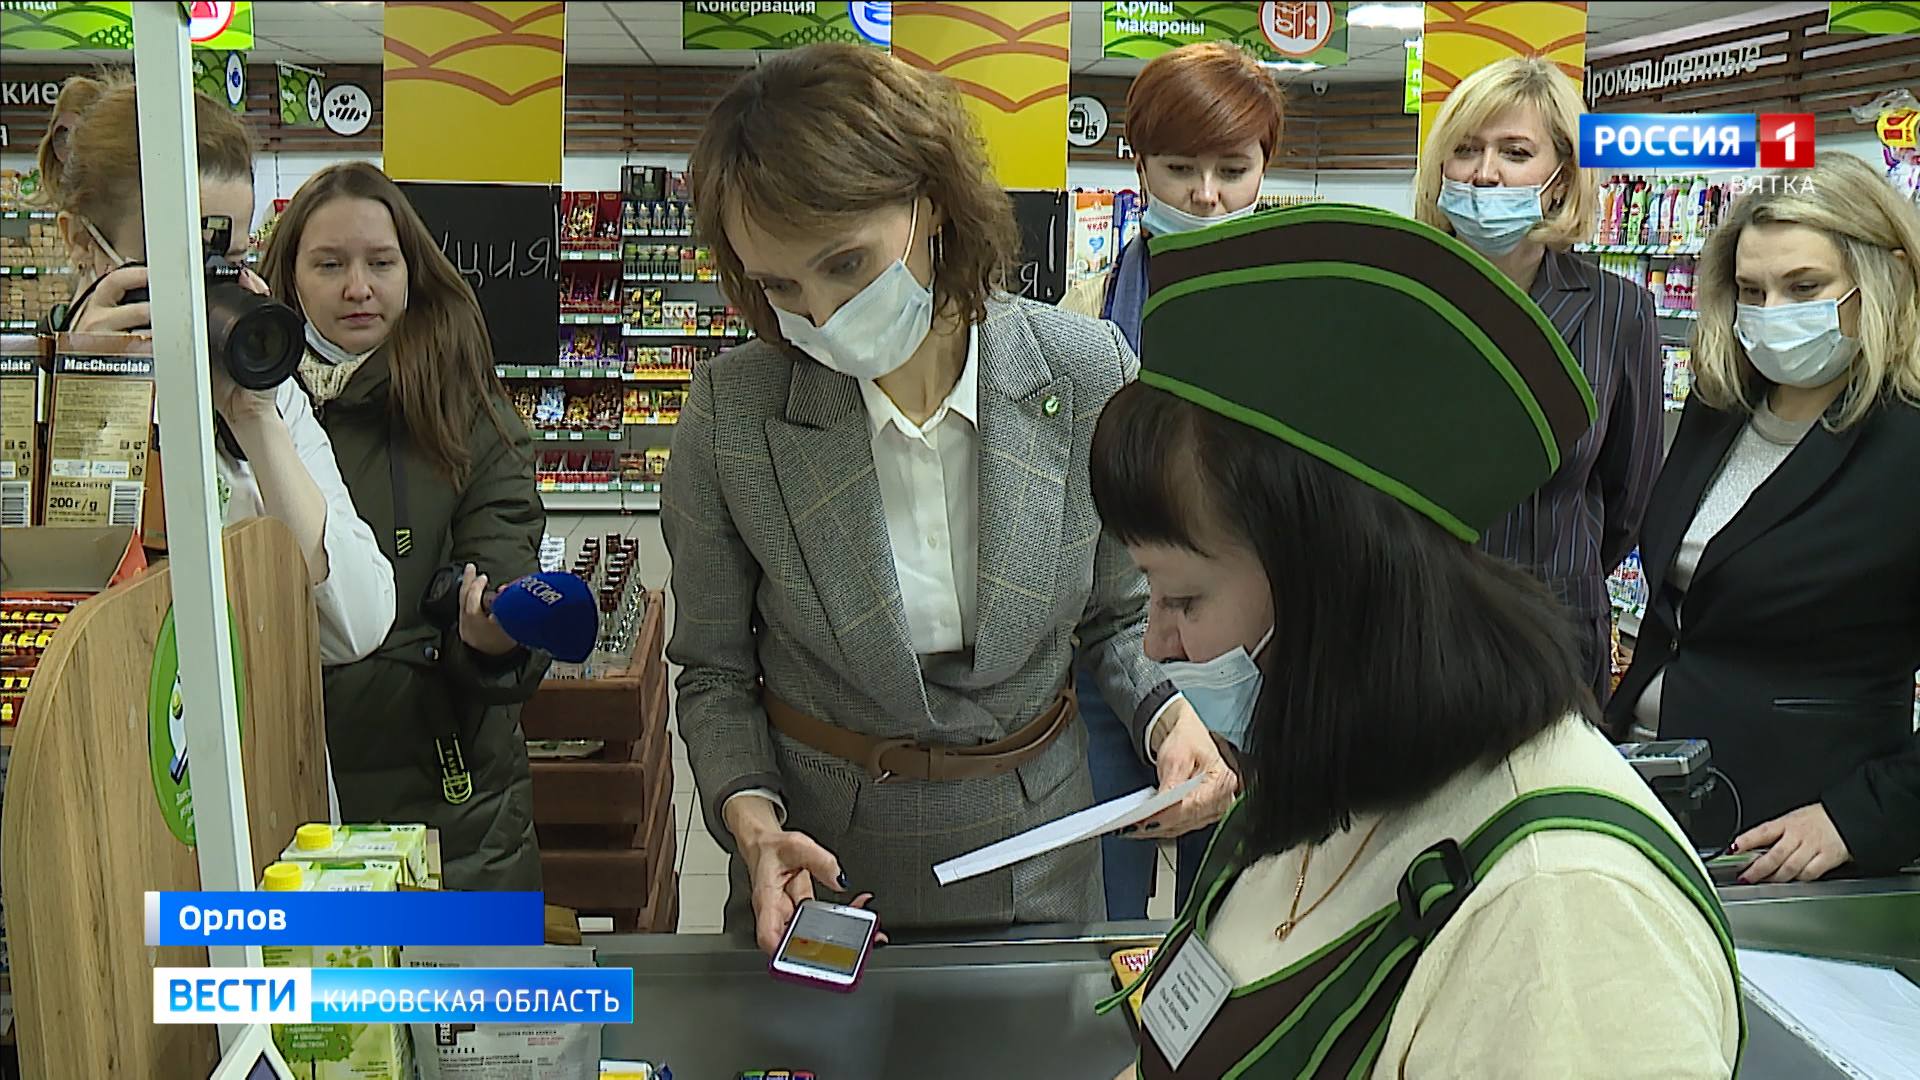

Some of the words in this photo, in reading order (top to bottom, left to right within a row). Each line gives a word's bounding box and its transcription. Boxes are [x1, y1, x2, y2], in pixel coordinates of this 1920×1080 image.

[696, 1, 816, 16] Консервация
[1116, 1, 1173, 17] Крупы
[1116, 18, 1205, 38] макароны
[64, 359, 150, 372] MacChocolate
